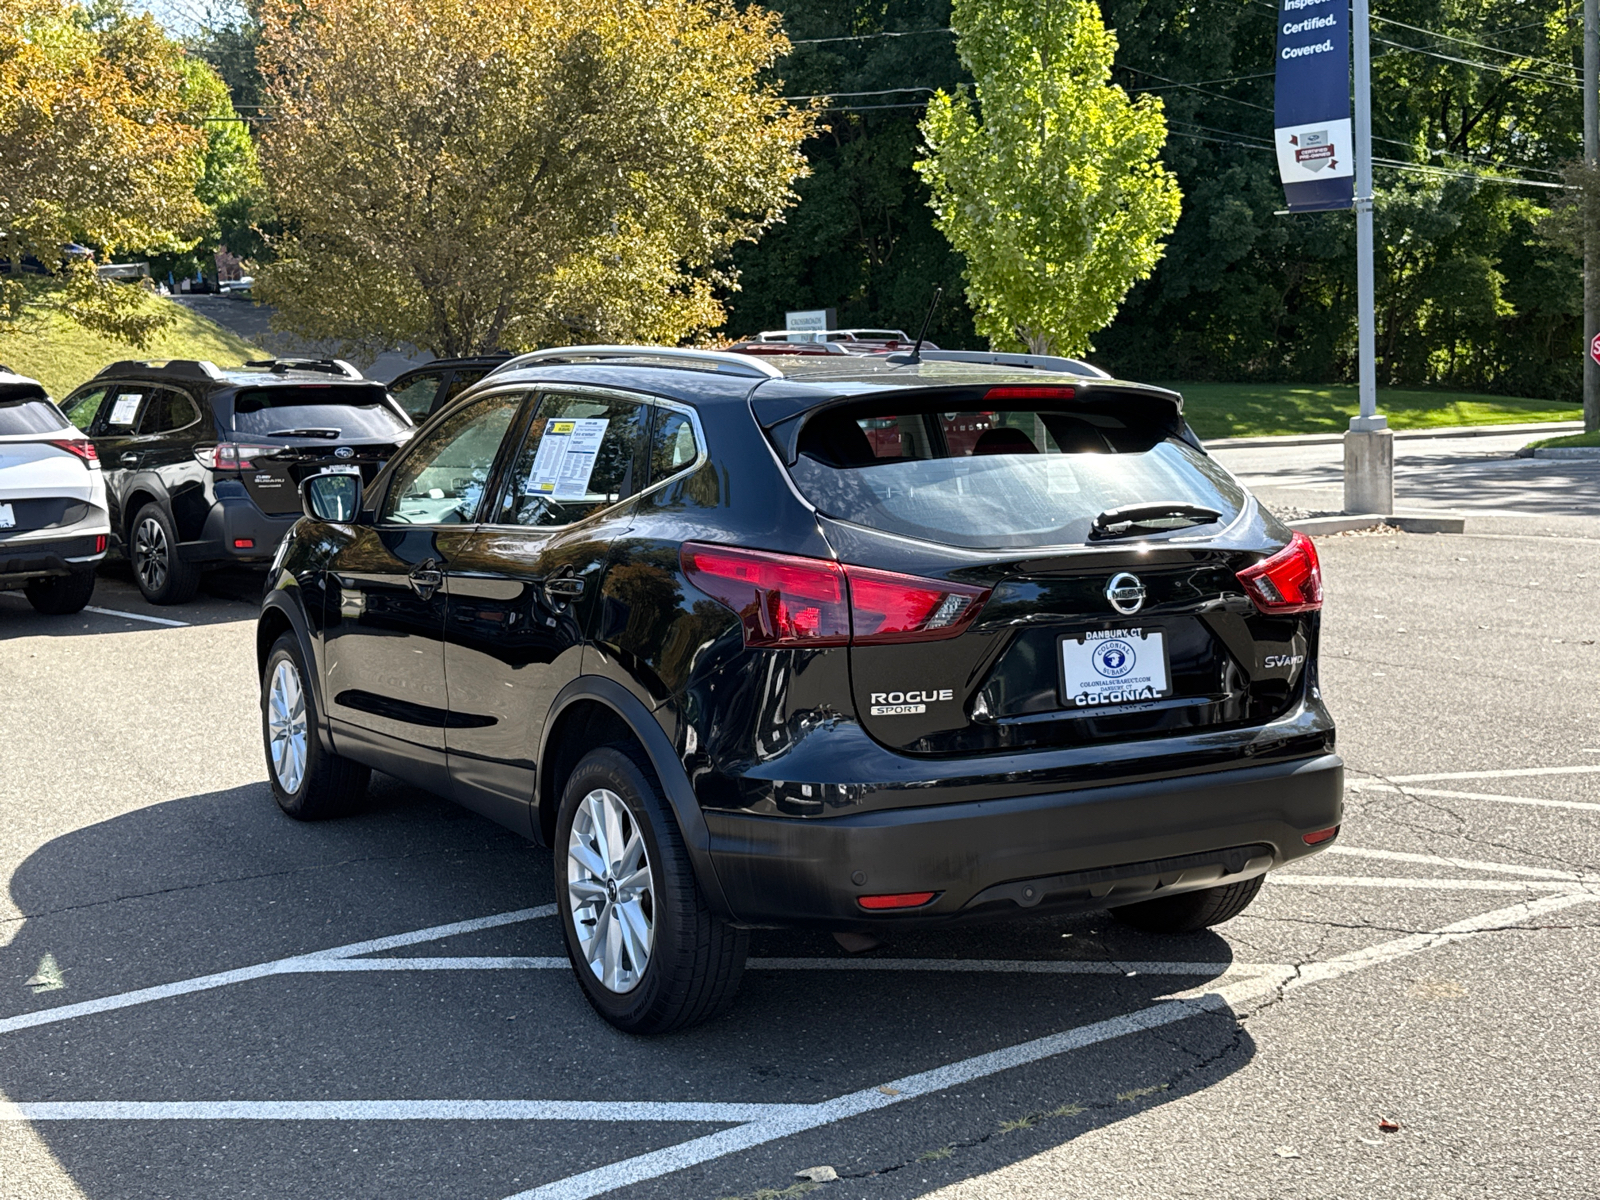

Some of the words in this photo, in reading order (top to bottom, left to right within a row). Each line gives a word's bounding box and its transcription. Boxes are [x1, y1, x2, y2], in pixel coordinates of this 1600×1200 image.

[1283, 13, 1337, 35] Certified.
[1282, 39, 1334, 59] Covered.
[1299, 152, 1331, 160] PRE-OWNED
[1301, 147, 1328, 155] CERTIFIED
[1131, 628, 1142, 637] CT
[1097, 642, 1130, 656] COLONIAL
[1103, 665, 1128, 676] SUBARU
[870, 689, 954, 704] ROGUE
[1075, 688, 1162, 706] COLONIAL
[877, 705, 920, 714] SPORT
